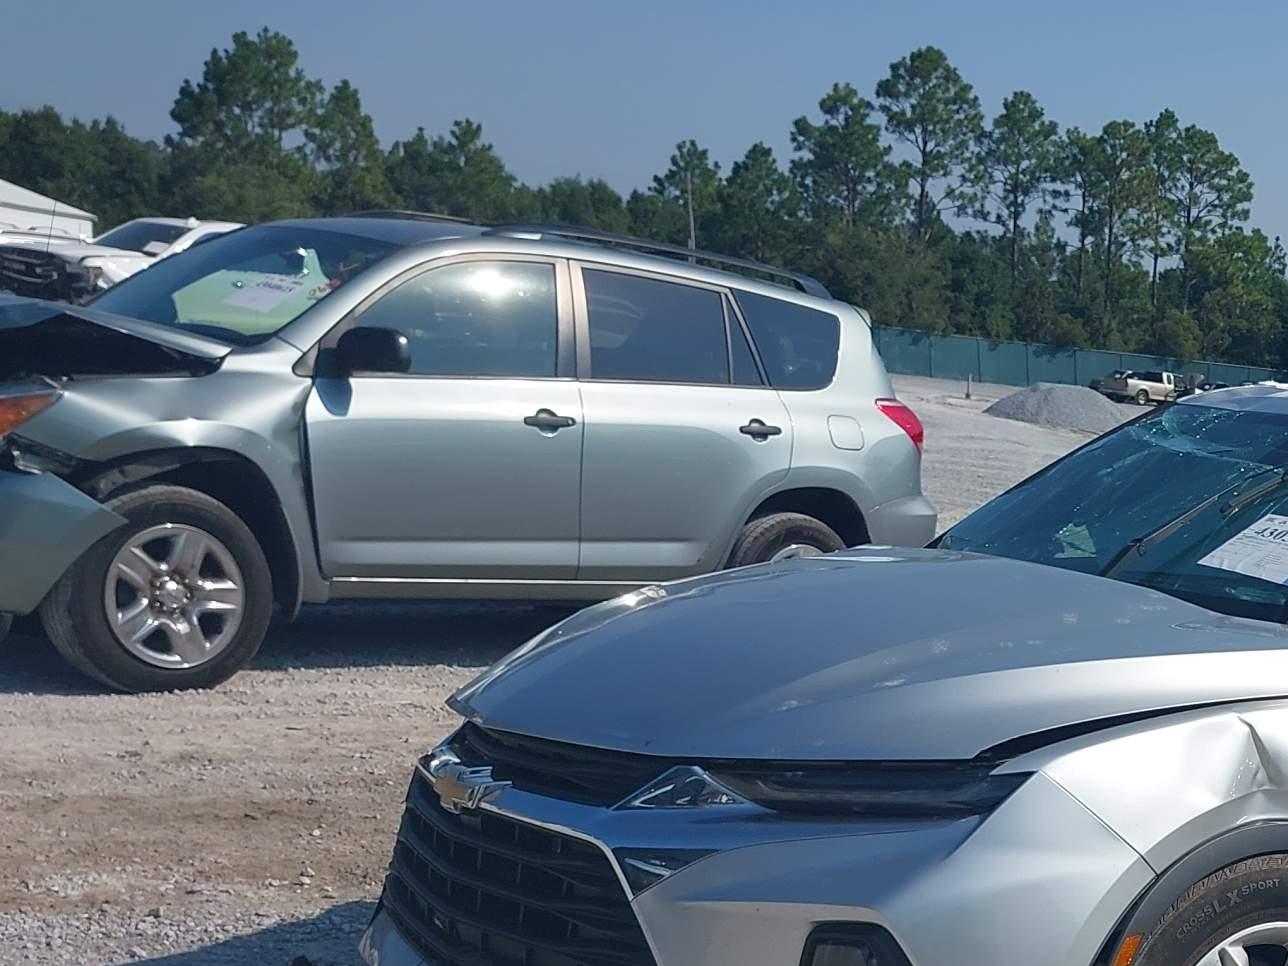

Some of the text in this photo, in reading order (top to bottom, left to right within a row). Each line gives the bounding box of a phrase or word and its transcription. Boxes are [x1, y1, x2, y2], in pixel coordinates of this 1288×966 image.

[1175, 878, 1281, 939] CROSS LX SPORT
